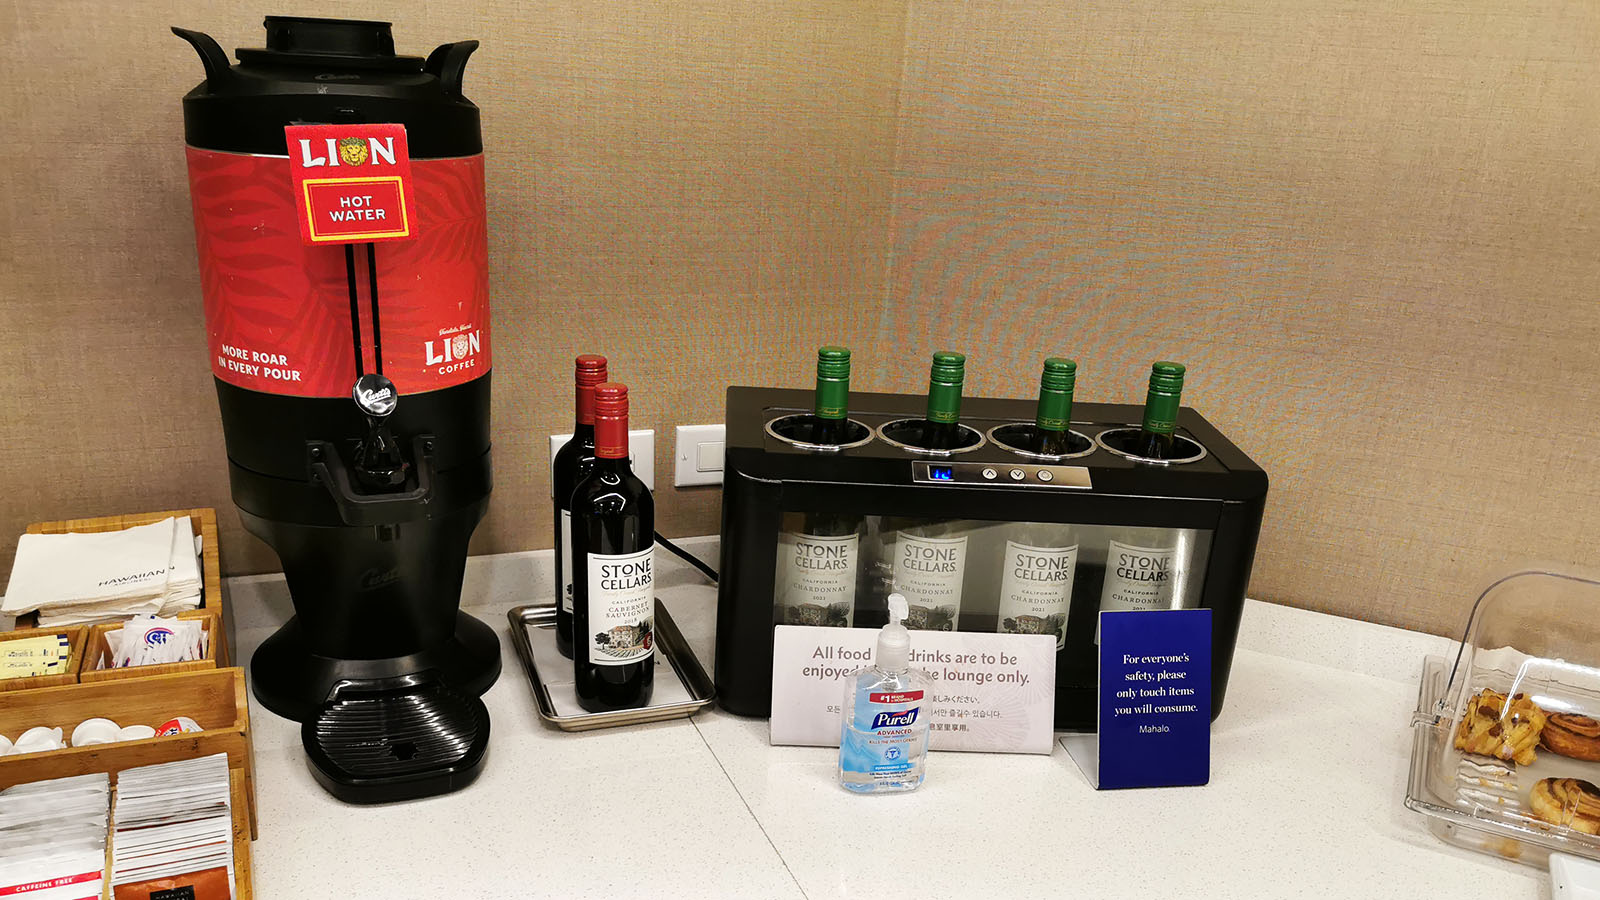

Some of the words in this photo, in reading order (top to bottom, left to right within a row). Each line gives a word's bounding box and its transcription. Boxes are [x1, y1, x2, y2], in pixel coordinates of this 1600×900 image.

[299, 137, 397, 168] LION
[340, 196, 373, 208] HOT
[329, 209, 386, 222] WATER
[222, 344, 249, 360] MORE
[252, 351, 288, 366] ROAR
[424, 330, 481, 366] LION
[218, 356, 226, 368] IN
[228, 360, 260, 376] EVERY
[263, 367, 301, 381] POUR
[438, 359, 475, 375] COFFEE
[797, 542, 848, 558] STONE
[904, 543, 957, 561] STONE
[601, 558, 651, 578] STONE
[1016, 554, 1069, 570] STONE
[1119, 553, 1170, 570] STONE
[98, 569, 165, 587] HAWAIIAN
[601, 572, 652, 590] CELLARS
[1116, 567, 1169, 582] CELLARS
[793, 583, 847, 593] CHARDONNAY
[606, 606, 650, 618] SAUVIGNON
[608, 601, 649, 613] CABERNET
[812, 646, 833, 659] All
[837, 646, 871, 660] food
[908, 649, 952, 664] drinks
[955, 654, 977, 664] are
[981, 653, 996, 665] to
[1000, 652, 1017, 665] be
[1123, 653, 1140, 665] For
[1141, 652, 1190, 665] everyone's
[943, 668, 993, 685] lounge
[996, 670, 1030, 686] only.
[1124, 670, 1155, 682] safety,
[1157, 670, 1187, 682] please
[1116, 687, 1137, 700] only
[1140, 687, 1166, 697] touch
[1168, 687, 1195, 696] items
[1114, 707, 1132, 717] you
[1134, 703, 1152, 714] will
[1154, 704, 1198, 714] consume.
[877, 712, 915, 726] Purell
[16, 882, 53, 892] CAFFEINE
